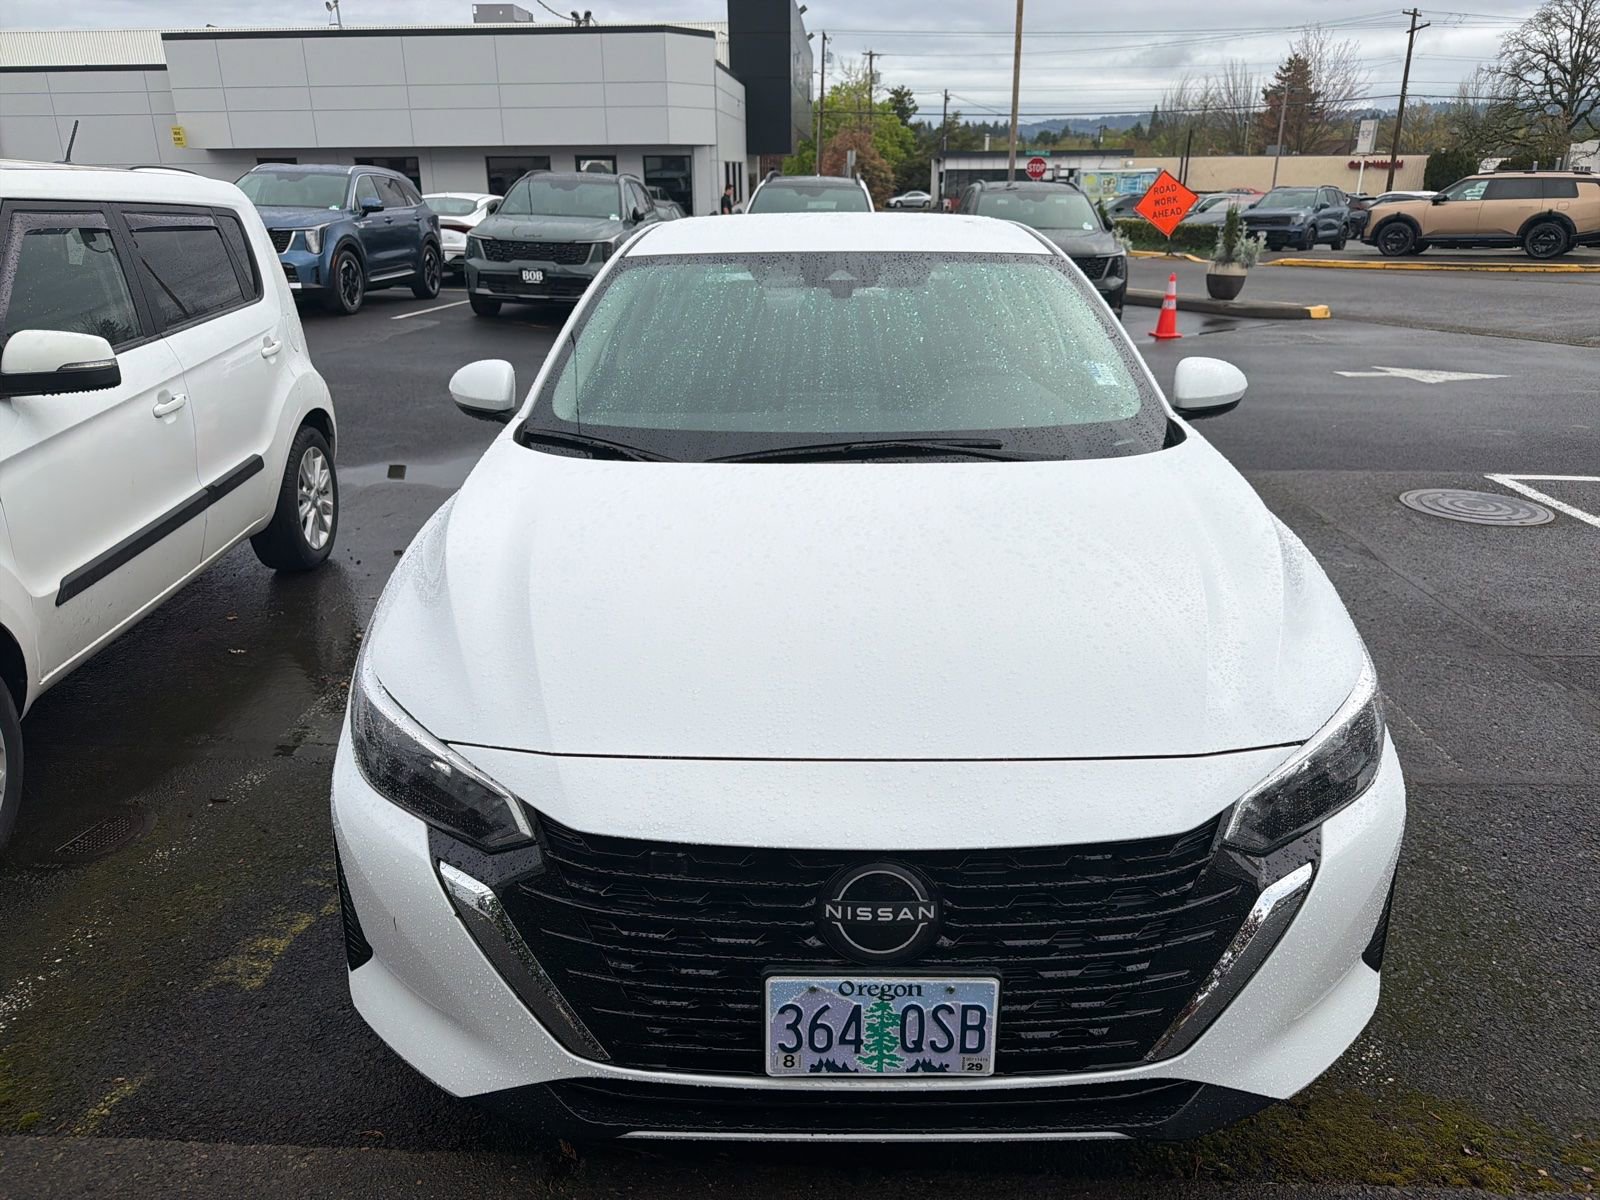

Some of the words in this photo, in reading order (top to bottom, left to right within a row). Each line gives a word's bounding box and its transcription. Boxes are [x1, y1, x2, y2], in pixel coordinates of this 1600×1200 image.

[1028, 163, 1045, 173] STOP
[1153, 184, 1177, 195] ROAD
[1154, 196, 1178, 207] WORK
[1152, 207, 1182, 219] AHEAD
[522, 270, 543, 280] BOB
[825, 904, 935, 921] NISSAN
[838, 981, 923, 1001] Oregon
[777, 1003, 863, 1054] 364
[899, 1003, 987, 1054] QSB
[783, 1055, 795, 1068] 8
[967, 1062, 983, 1071] 29
